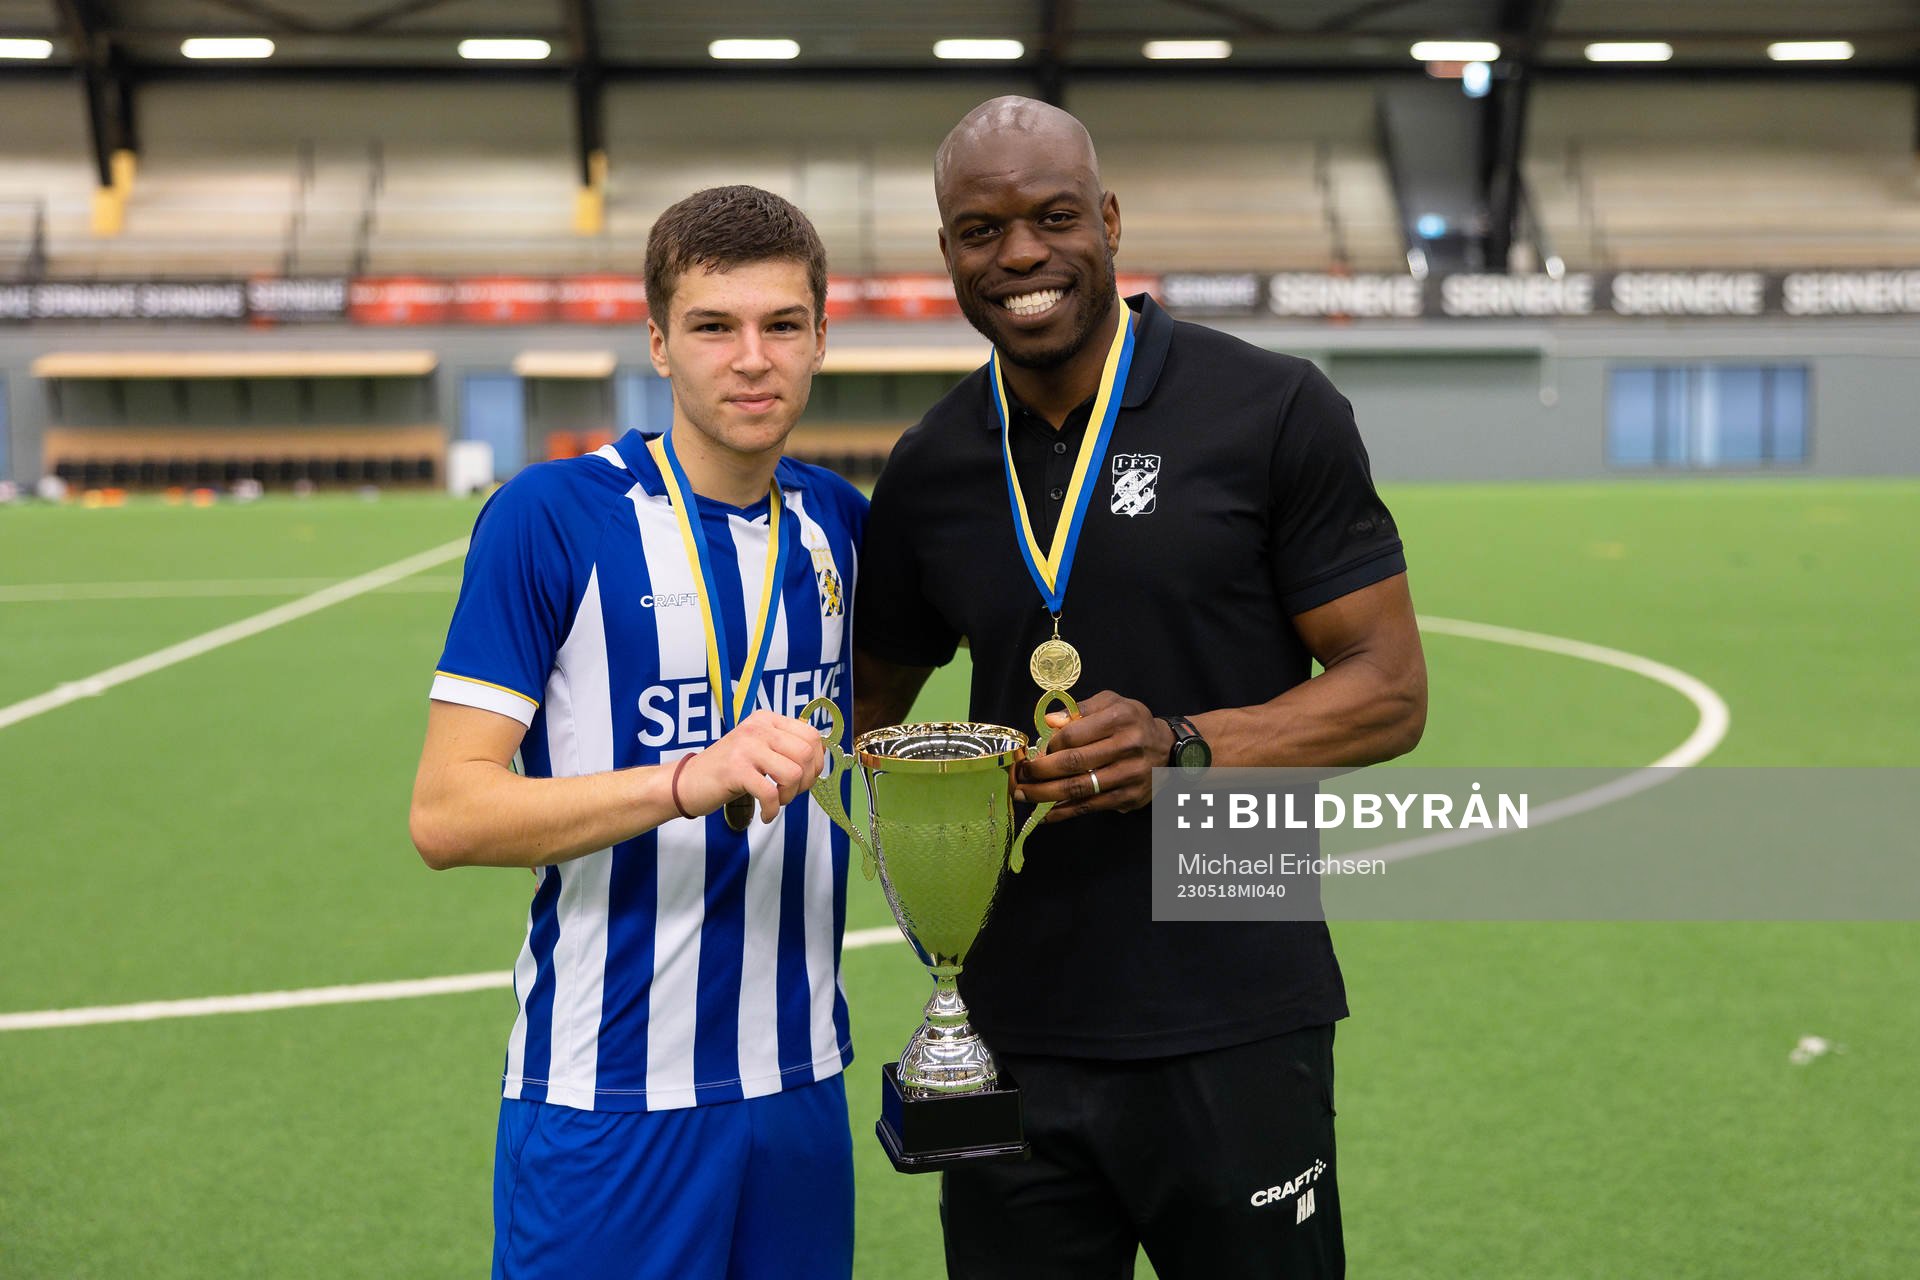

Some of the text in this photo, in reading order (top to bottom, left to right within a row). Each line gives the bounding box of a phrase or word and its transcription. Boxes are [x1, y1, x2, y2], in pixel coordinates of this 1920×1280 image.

[640, 592, 698, 608] CRAFT
[1250, 1166, 1314, 1207] CRAFT
[1296, 1187, 1316, 1225] HA
